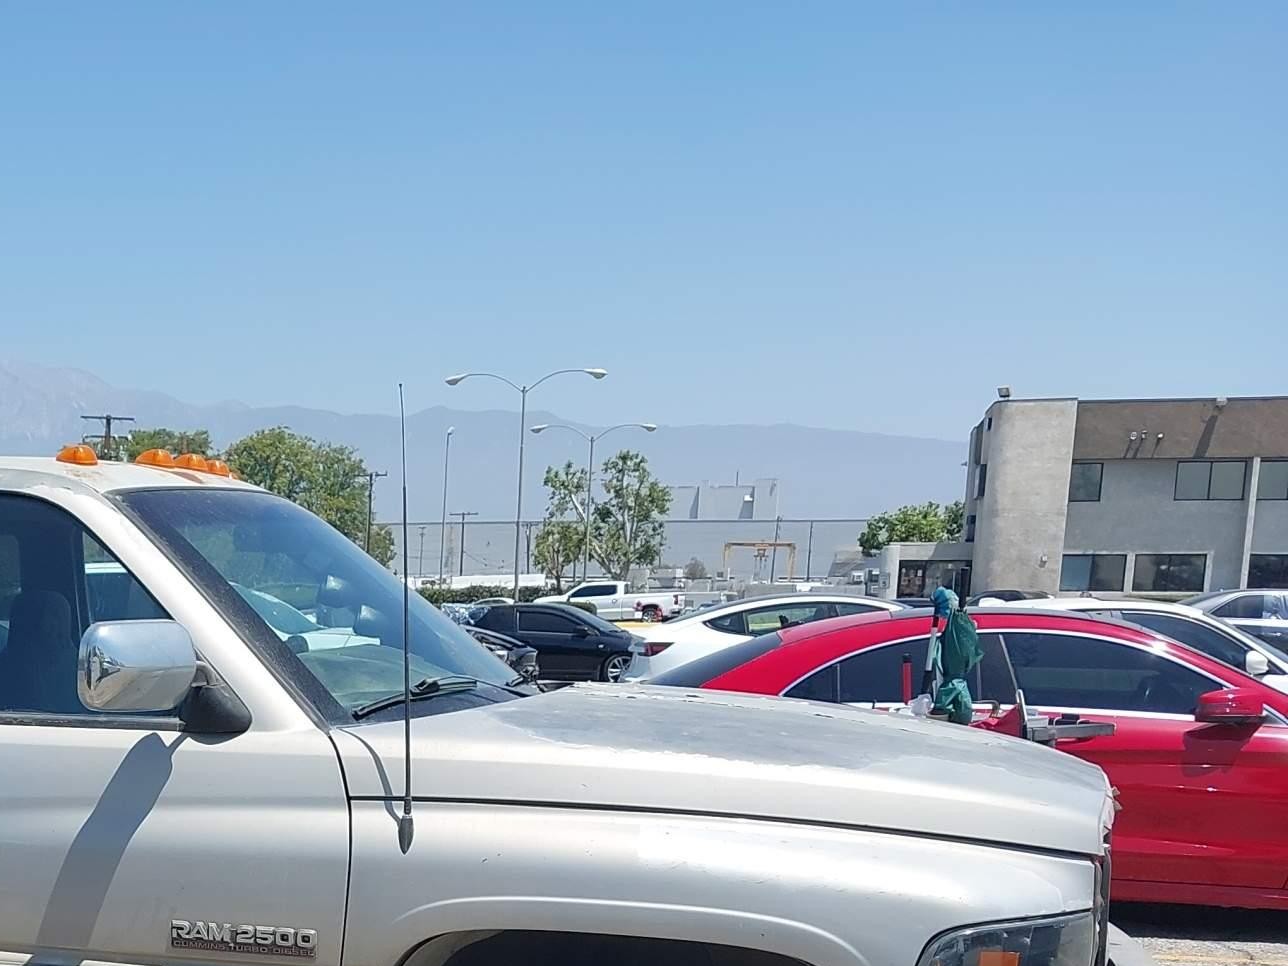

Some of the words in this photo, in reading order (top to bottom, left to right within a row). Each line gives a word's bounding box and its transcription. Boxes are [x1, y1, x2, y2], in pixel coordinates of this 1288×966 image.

[171, 919, 232, 943] RAM
[236, 924, 318, 948] 2500
[172, 939, 227, 951] CUMMINS
[229, 942, 269, 954] TURBO
[272, 946, 316, 957] DIESEL
